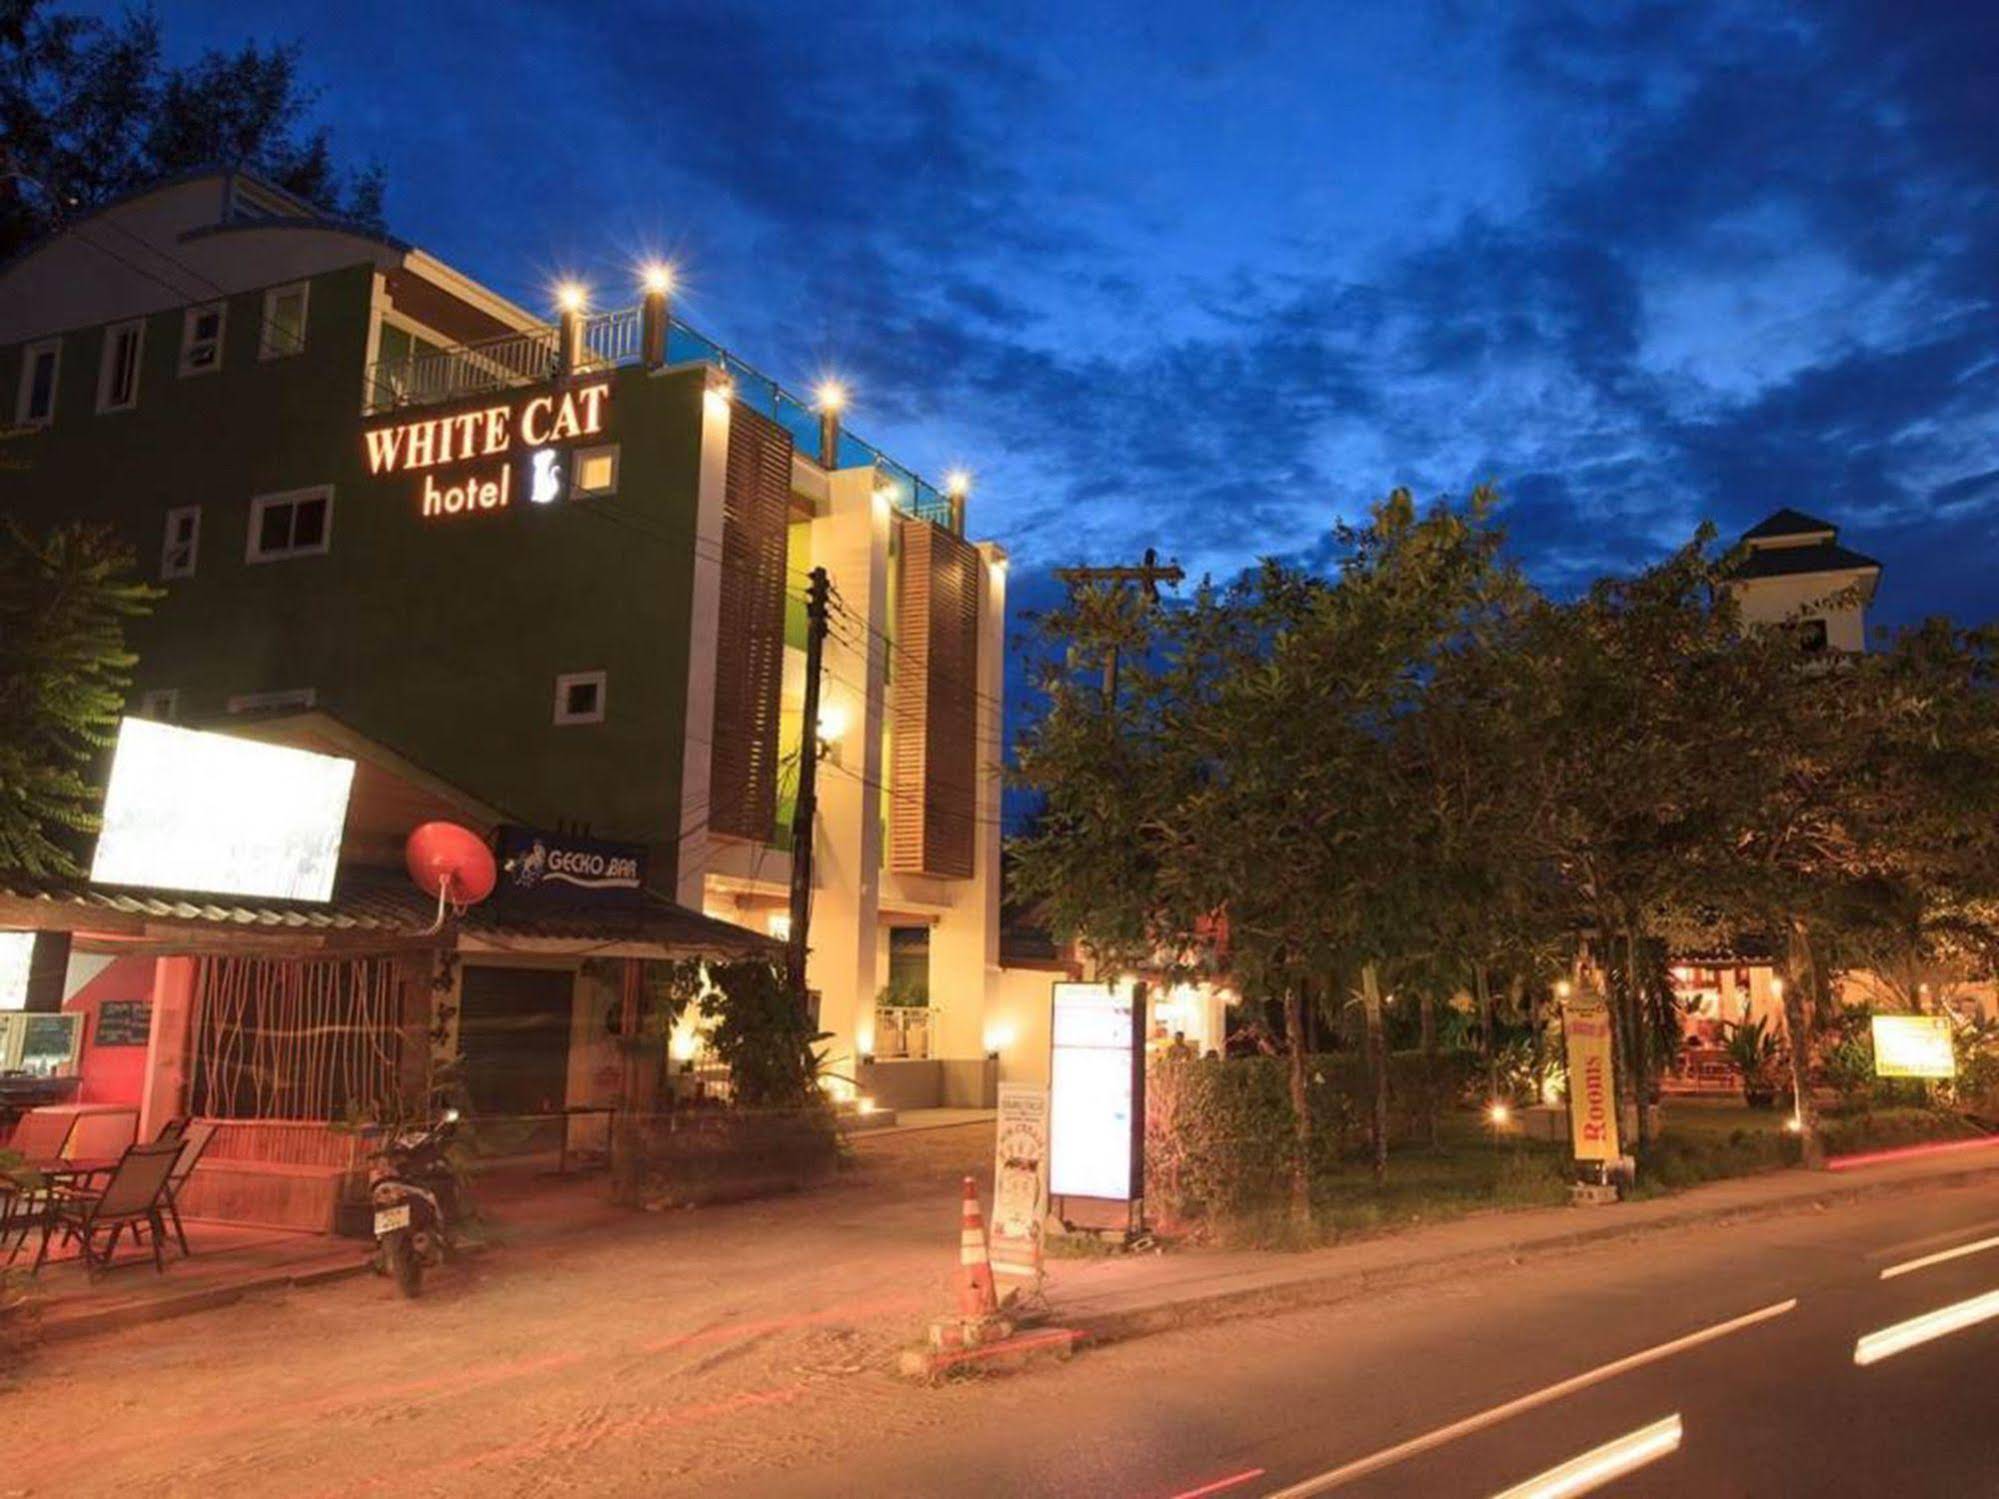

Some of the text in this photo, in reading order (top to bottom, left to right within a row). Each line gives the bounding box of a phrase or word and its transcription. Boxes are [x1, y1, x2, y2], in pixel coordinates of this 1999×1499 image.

[365, 385, 609, 475] WHITE CAT
[423, 464, 511, 516] hotel
[548, 850, 638, 878] GECKO BAR
[1584, 1056, 1607, 1141] Rooms
